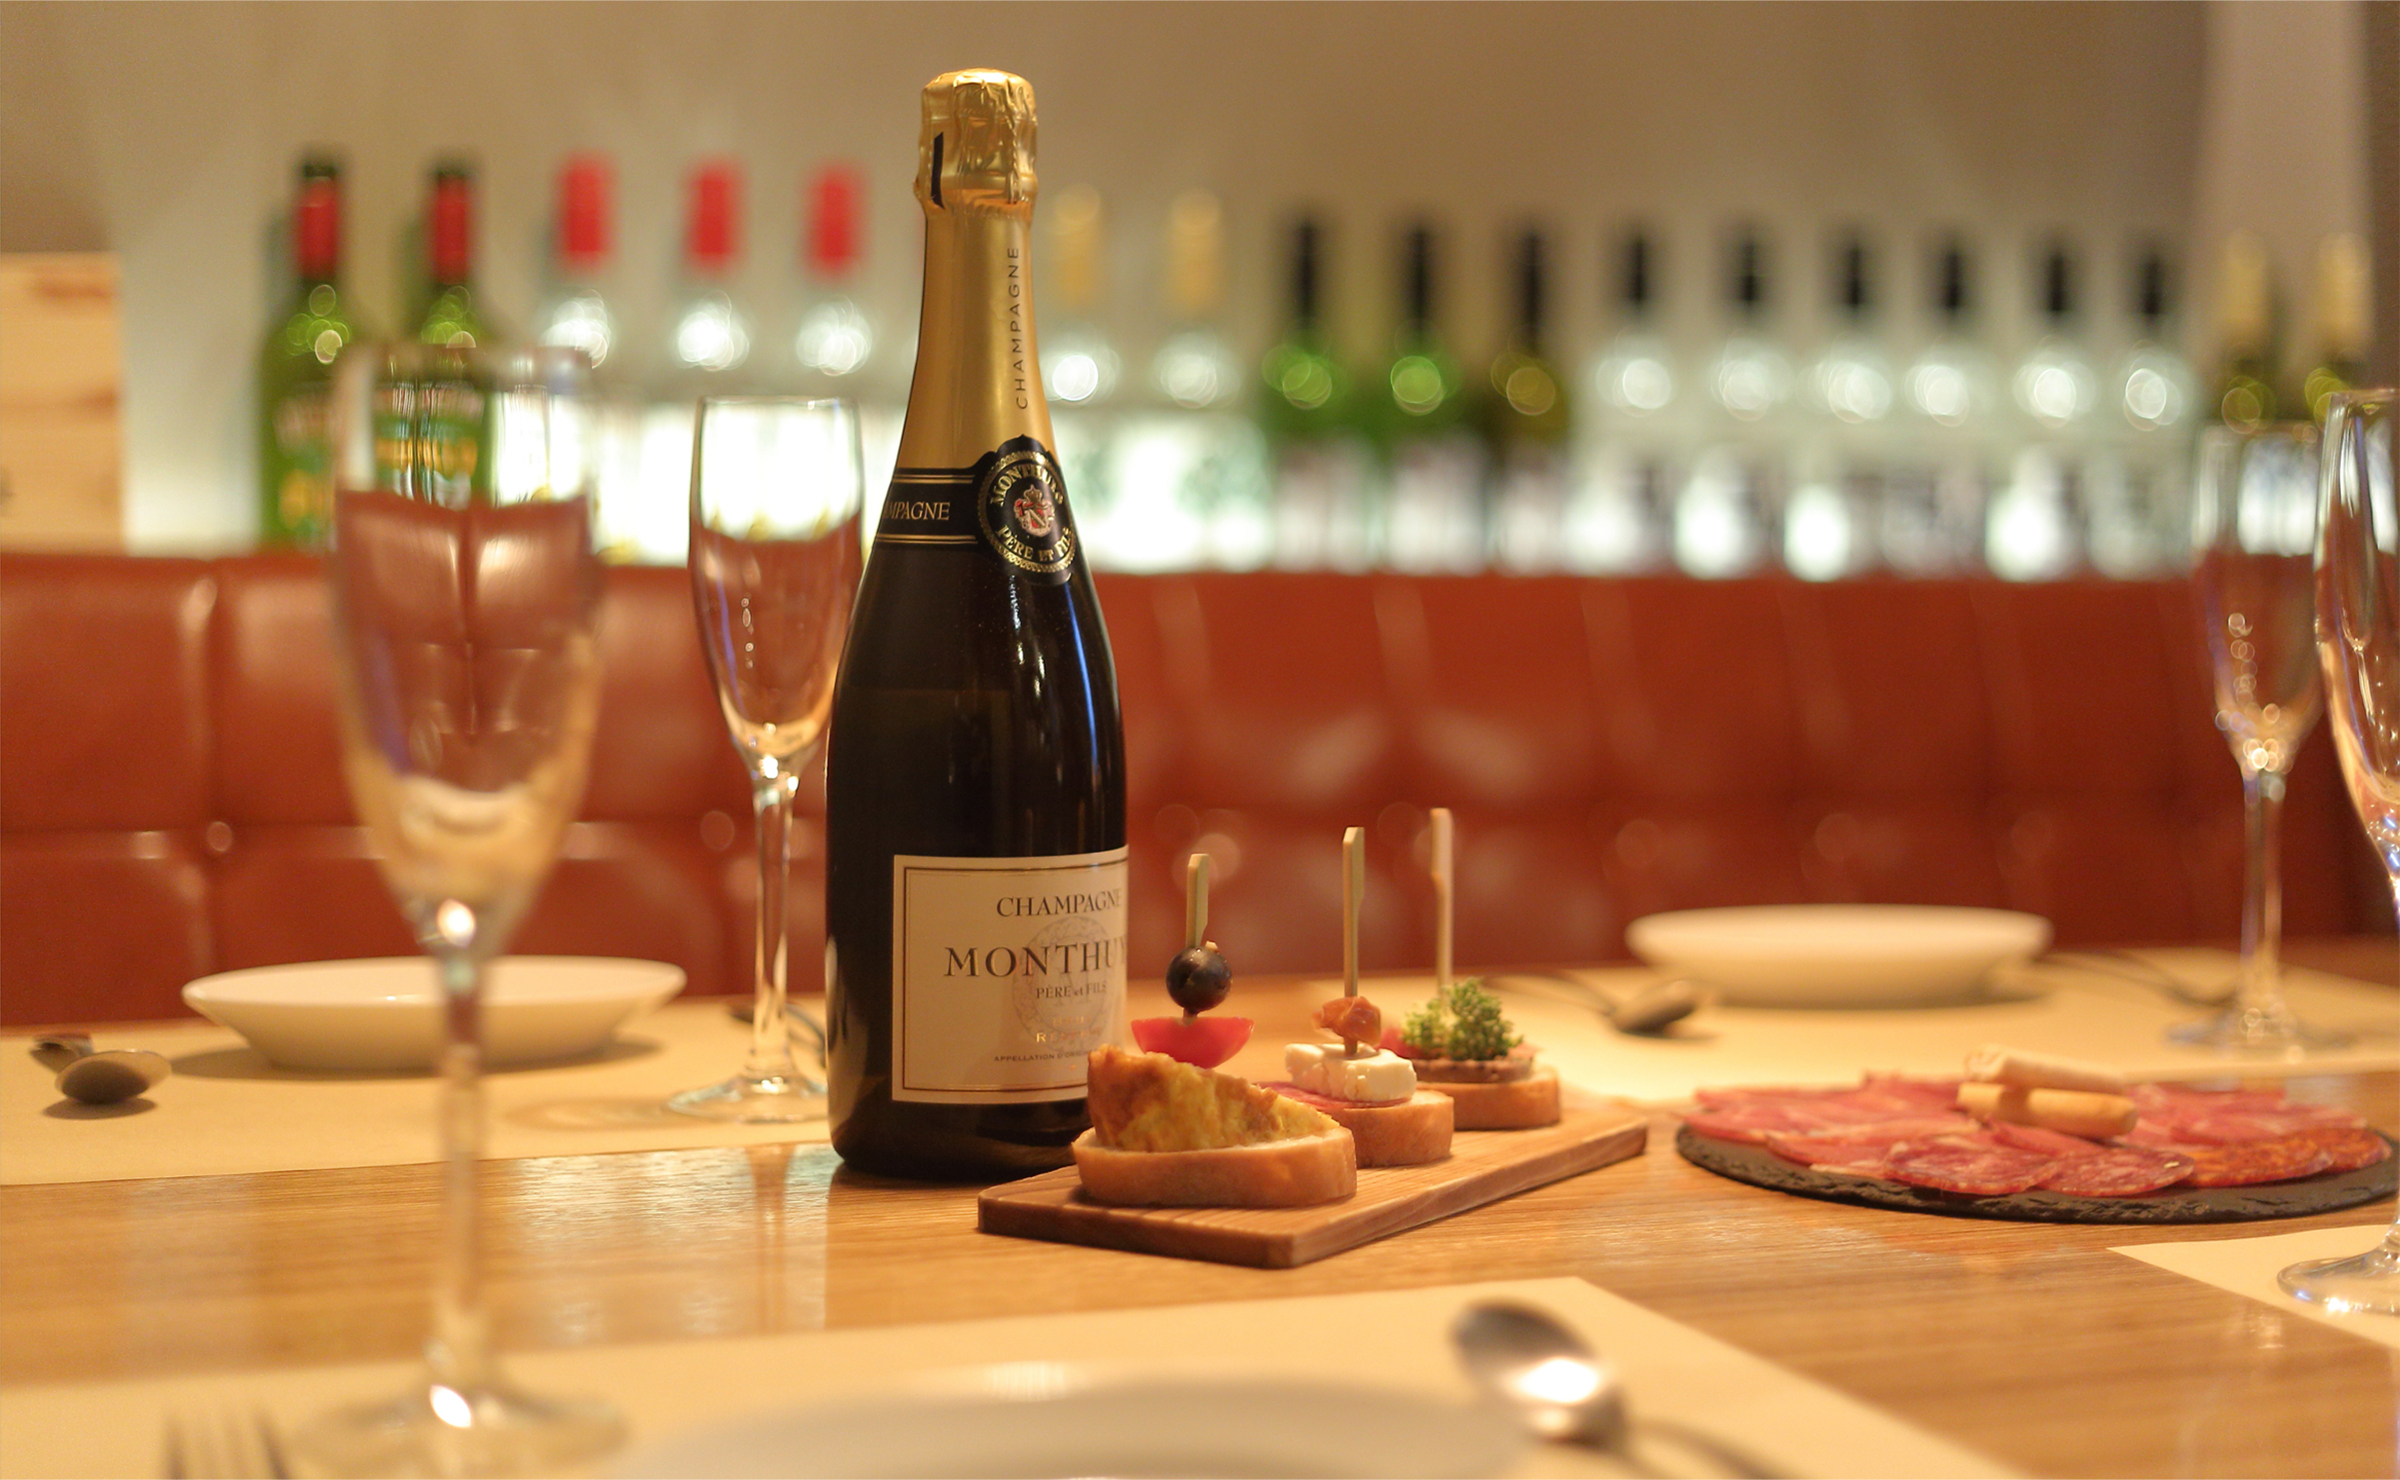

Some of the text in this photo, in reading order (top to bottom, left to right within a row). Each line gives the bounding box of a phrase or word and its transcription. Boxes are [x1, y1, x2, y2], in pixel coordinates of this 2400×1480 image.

[1007, 247, 1028, 409] CHAMPAGNE
[995, 888, 1121, 918] CHAMPAGNE
[1086, 981, 1107, 996] FILS
[993, 1054, 1055, 1062] APPELLATION
